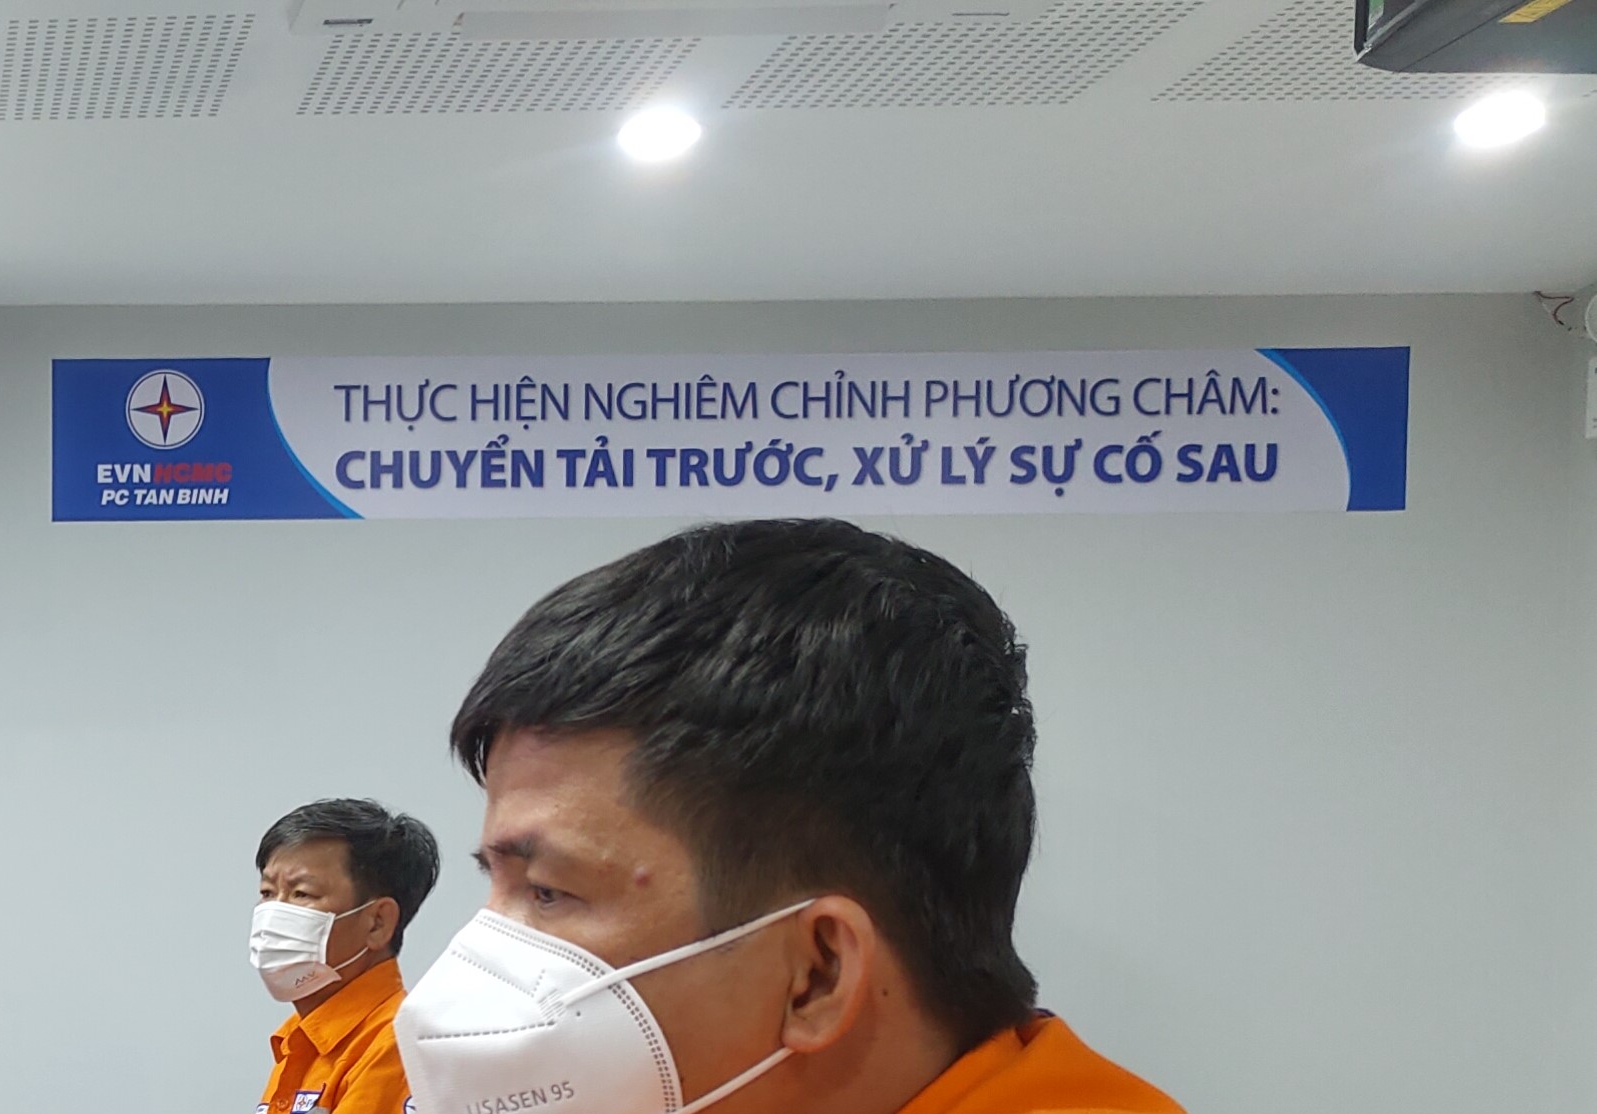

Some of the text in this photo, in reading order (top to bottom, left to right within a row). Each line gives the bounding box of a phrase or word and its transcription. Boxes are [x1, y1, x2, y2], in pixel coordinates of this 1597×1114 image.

[333, 369, 1280, 432] THỰC HIỆN NGHIÊM CHỈNH PHƯƠNG CHÂM:
[334, 430, 1279, 497] CHUYỂN TẢI TRƯỚC, XỬ LÝ SỰ CỐ SAU
[101, 488, 229, 506] PC TAN BINH
[551, 1080, 575, 1101] 95
